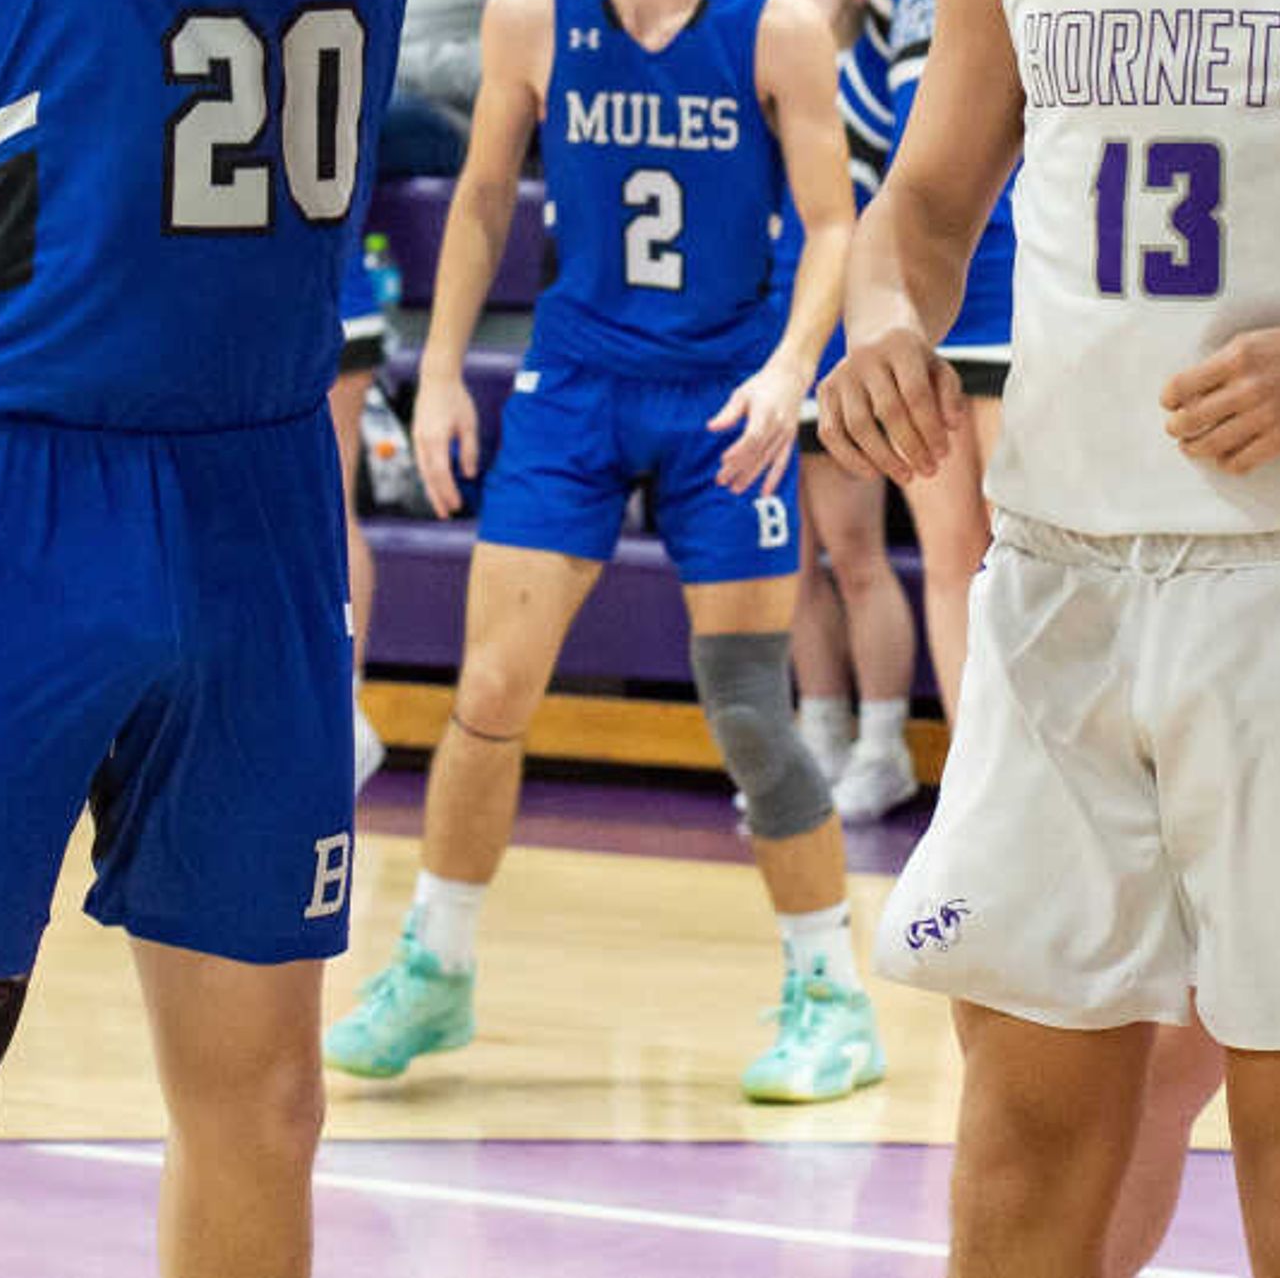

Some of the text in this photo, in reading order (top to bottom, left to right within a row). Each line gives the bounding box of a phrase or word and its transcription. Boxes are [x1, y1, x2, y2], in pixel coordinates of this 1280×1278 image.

[162, 2, 368, 235] 20
[566, 91, 740, 151] MULES
[622, 168, 684, 291] 2
[1090, 138, 1227, 301] 13
[753, 497, 789, 549] B
[304, 831, 349, 919] B
